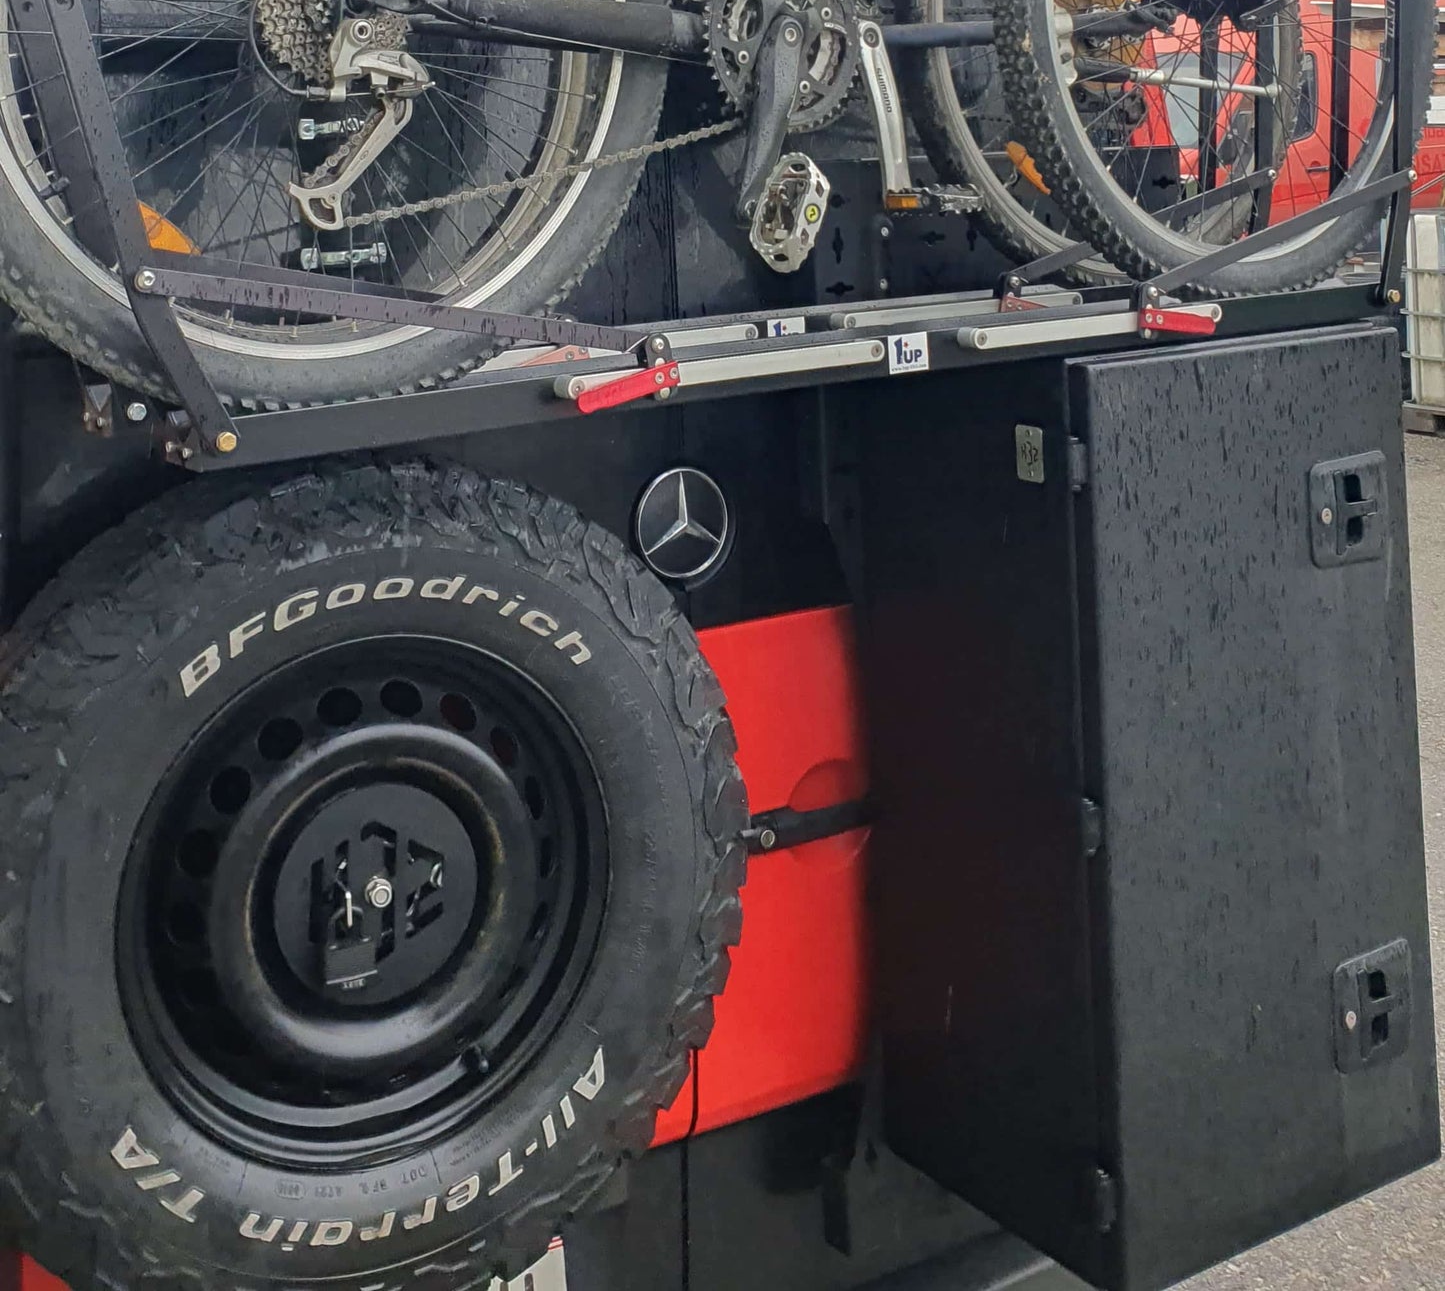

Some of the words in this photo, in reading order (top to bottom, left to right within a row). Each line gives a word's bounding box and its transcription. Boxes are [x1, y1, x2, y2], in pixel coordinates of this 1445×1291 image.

[893, 336, 923, 365] 1UP
[179, 575, 592, 698] BFGoodrich
[110, 1126, 205, 1223] T/A
[239, 1045, 605, 1252] All-Terrain
